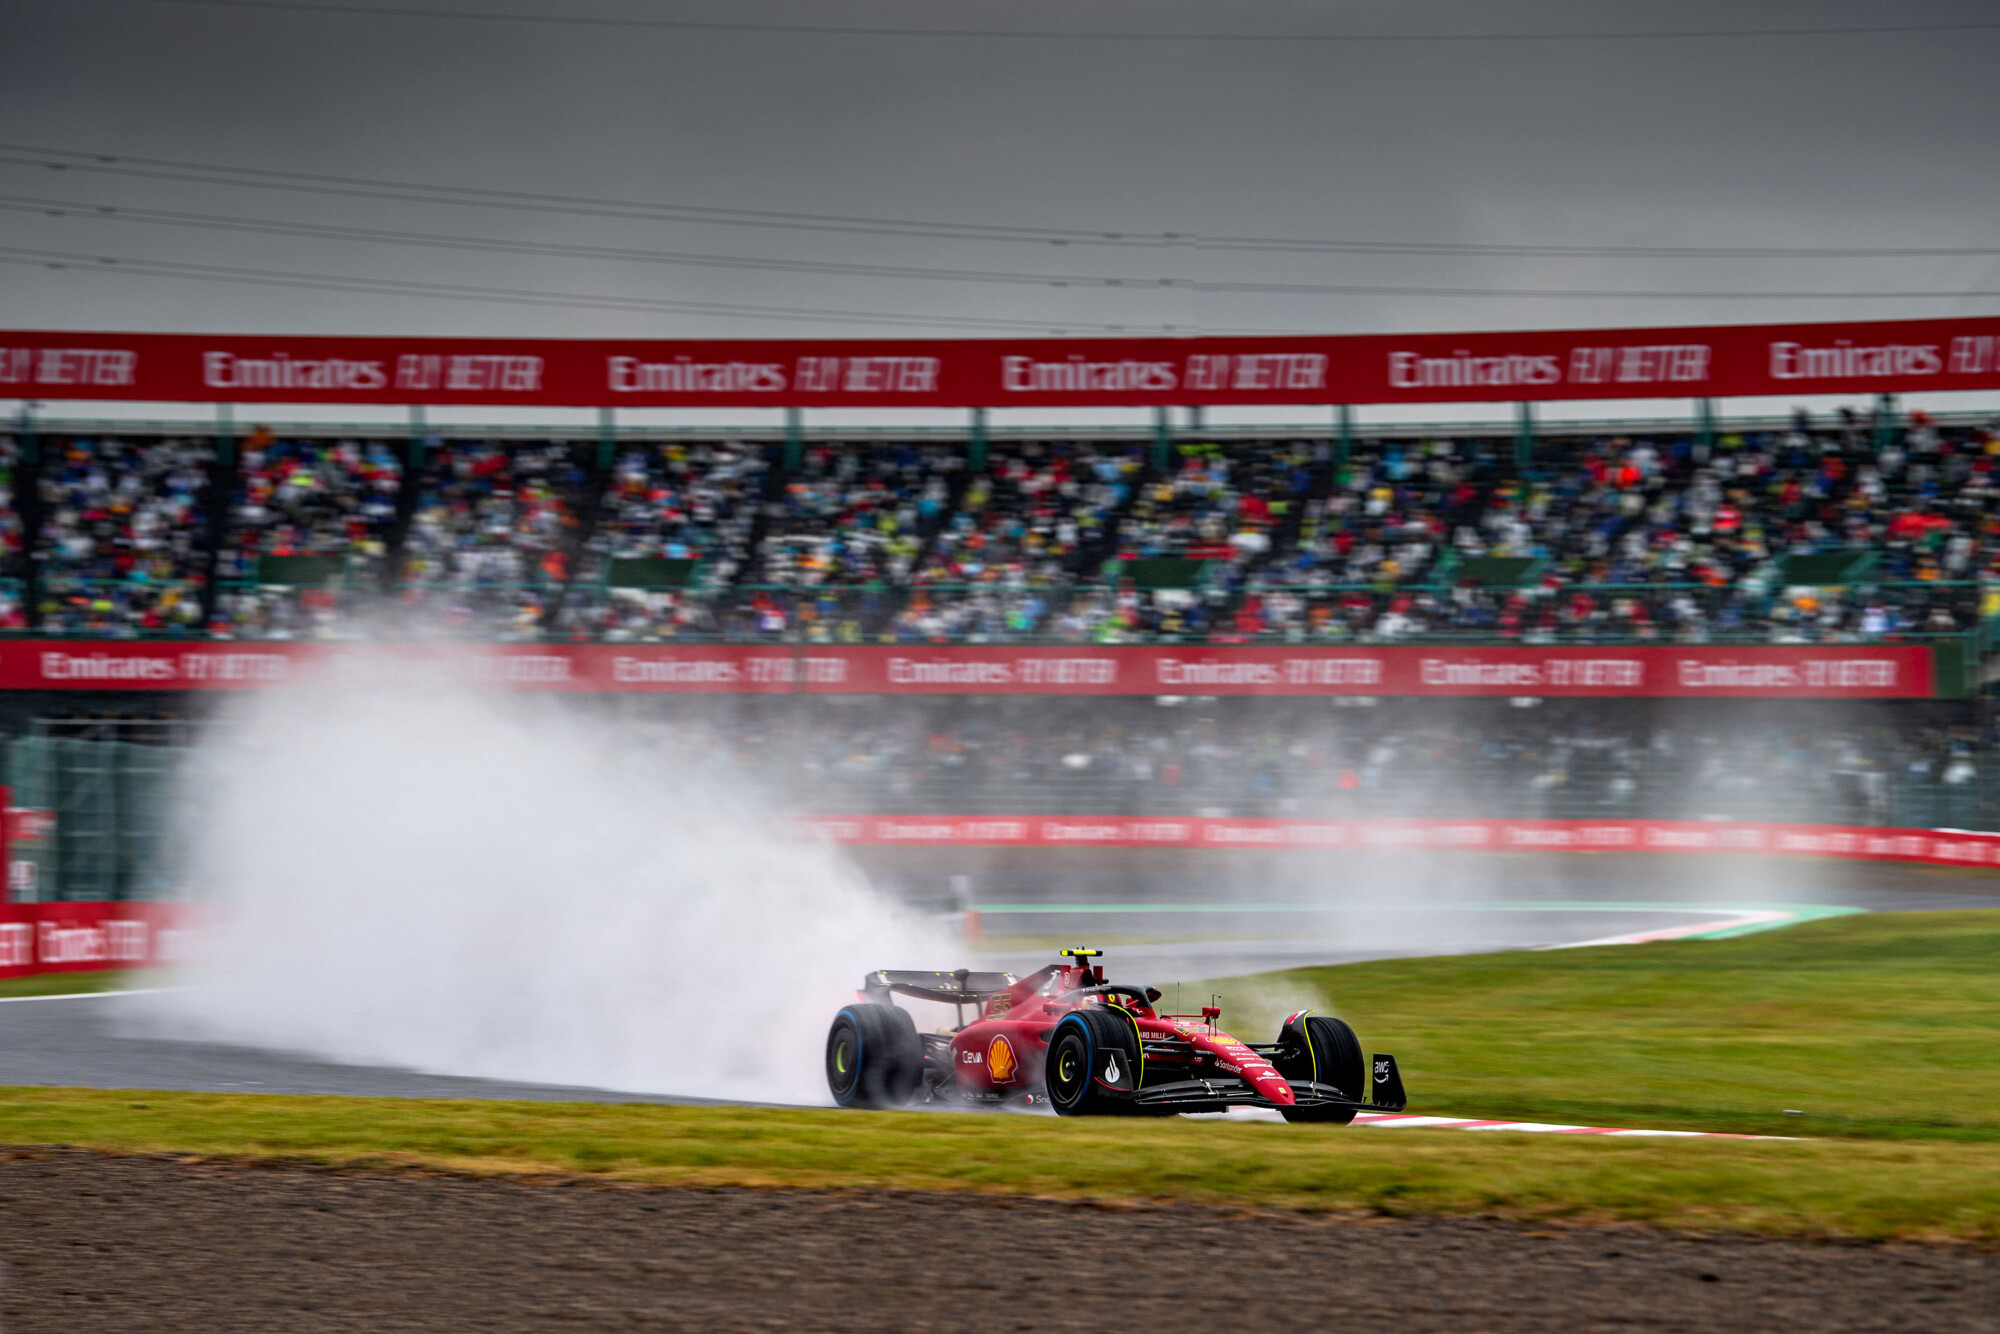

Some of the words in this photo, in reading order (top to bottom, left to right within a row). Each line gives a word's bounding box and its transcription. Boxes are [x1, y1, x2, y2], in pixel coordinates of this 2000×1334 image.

[202, 350, 388, 389] Emirates
[607, 354, 787, 393] Emirates
[1000, 354, 1178, 392] Emirates
[1387, 349, 1562, 388] Emirates
[1768, 339, 1943, 379] Emirates
[1140, 1031, 1150, 1039] ARD
[1151, 1031, 1166, 1039] MILLE
[1219, 1059, 1243, 1074] Santander
[1035, 1095, 1051, 1104] Sna
